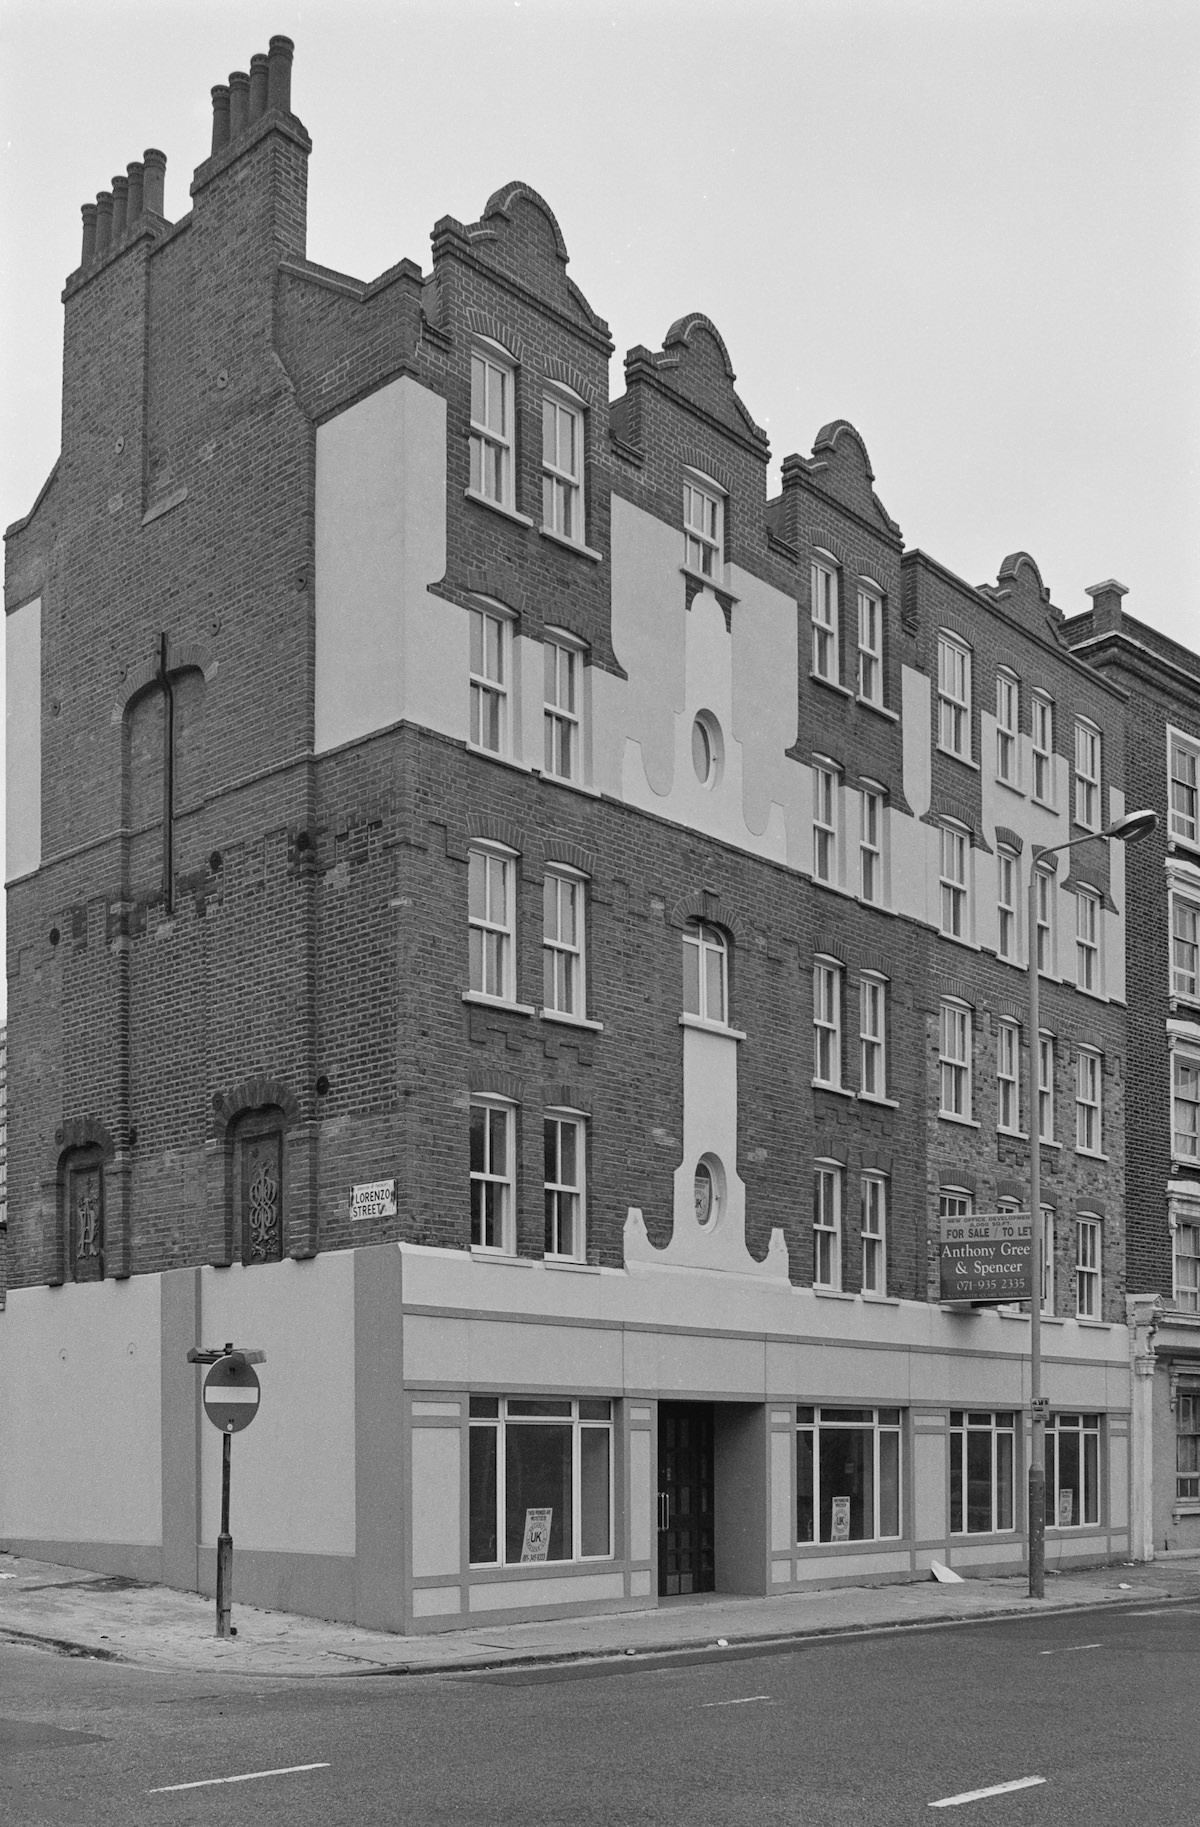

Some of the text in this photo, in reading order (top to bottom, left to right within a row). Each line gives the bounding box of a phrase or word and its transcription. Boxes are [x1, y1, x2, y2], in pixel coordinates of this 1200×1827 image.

[356, 1188, 390, 1204] LORENZO
[353, 1203, 381, 1217] STREET
[989, 1214, 1031, 1222] DEVELOPMEN
[947, 1229, 964, 1239] FOR
[968, 1228, 990, 1238] SALE
[1002, 1227, 1014, 1237] TO
[942, 1242, 1031, 1259] Anthony Gree
[956, 1260, 1022, 1276] & Spencer
[1001, 1278, 1025, 1289] 2335
[531, 1532, 541, 1542] UK
